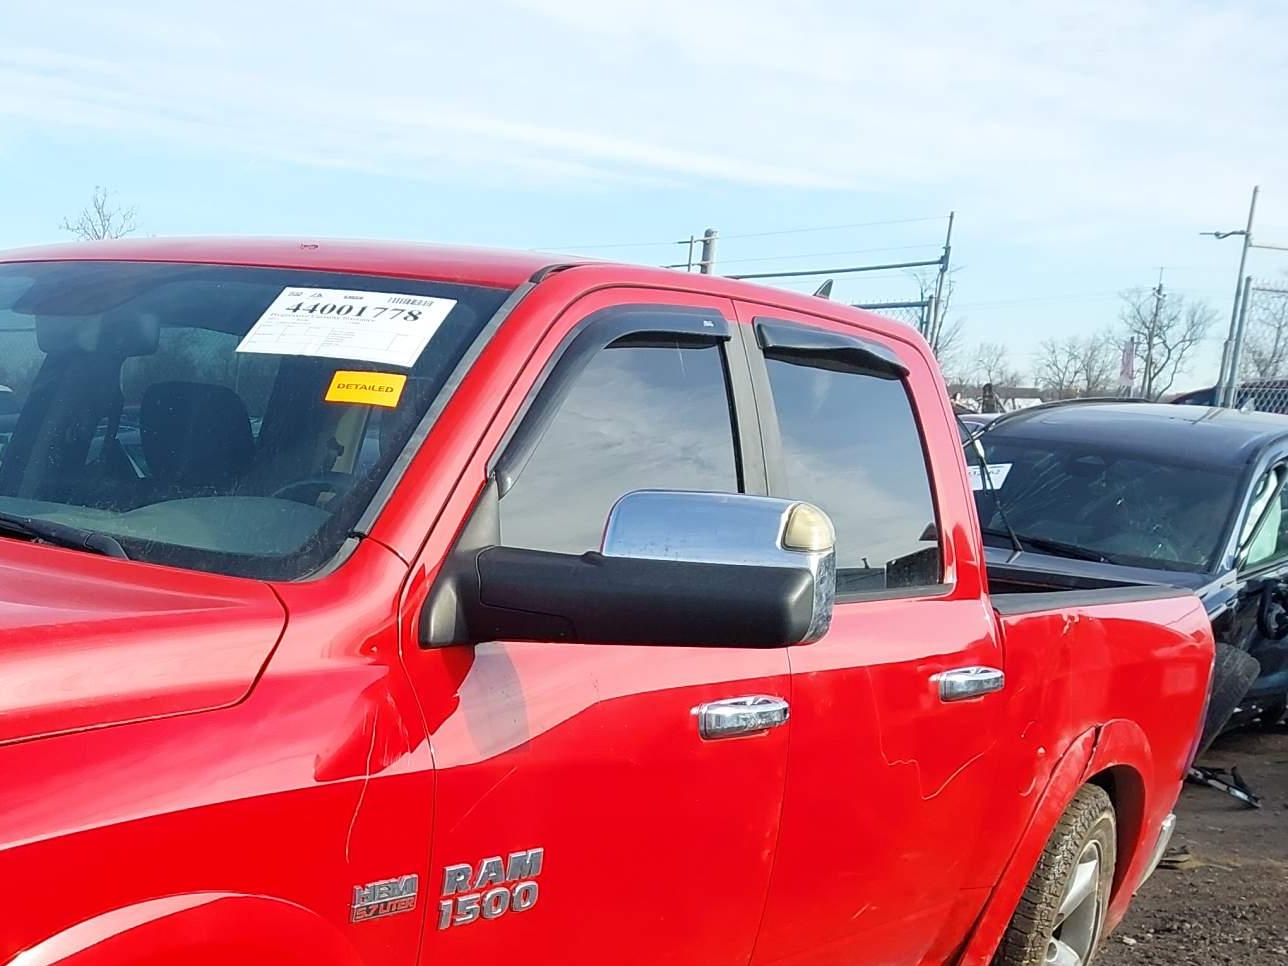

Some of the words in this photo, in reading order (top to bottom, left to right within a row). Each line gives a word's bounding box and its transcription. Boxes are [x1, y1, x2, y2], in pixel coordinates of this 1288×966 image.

[285, 301, 423, 322] 44001778
[336, 382, 395, 394] DETAILED
[442, 847, 544, 896] RAM
[438, 880, 539, 930] 1500
